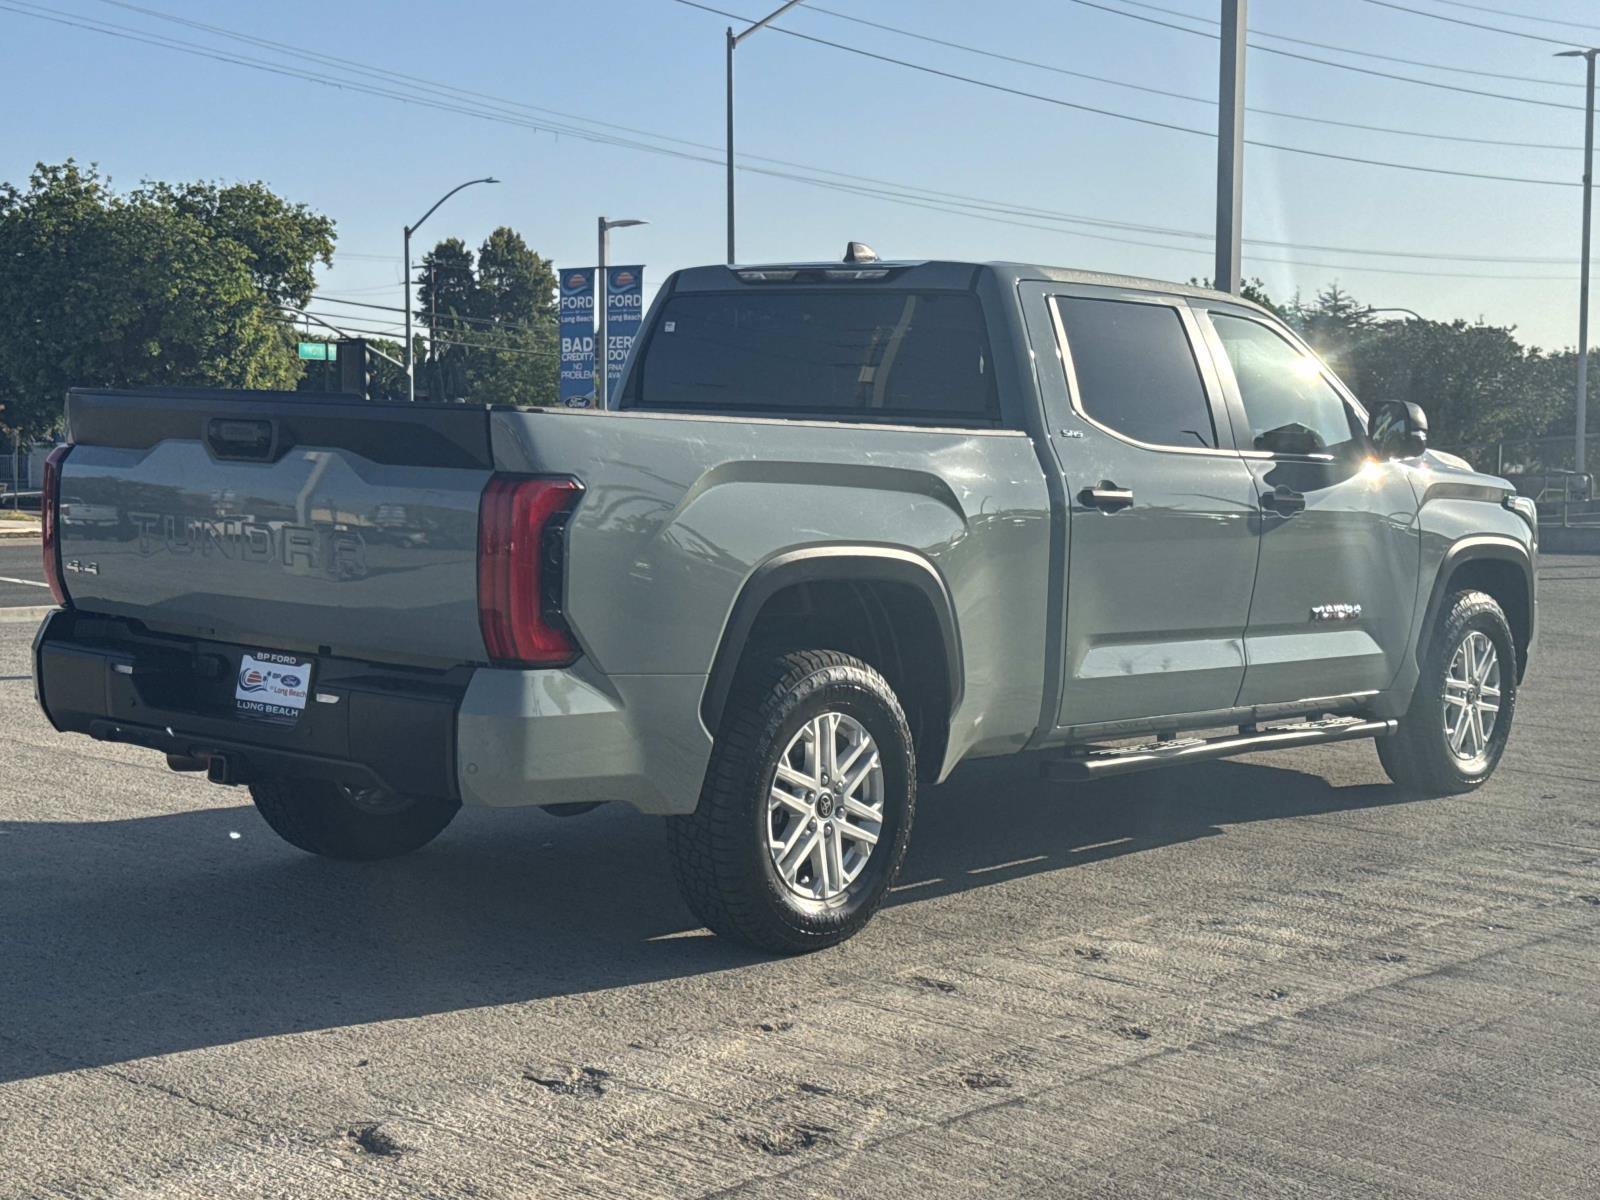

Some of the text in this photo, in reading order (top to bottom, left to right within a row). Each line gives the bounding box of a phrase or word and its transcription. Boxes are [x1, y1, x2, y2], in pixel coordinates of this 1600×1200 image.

[561, 296, 593, 309] FORD
[608, 294, 642, 307] FORD
[561, 315, 593, 324] Long Beach
[608, 313, 641, 322] Long Beach
[562, 337, 593, 352] BAD
[561, 352, 594, 361] CREDIT?
[127, 511, 367, 577] TUNDRA
[257, 652, 297, 664] BP FORD
[237, 700, 299, 717] LONG BEACH
